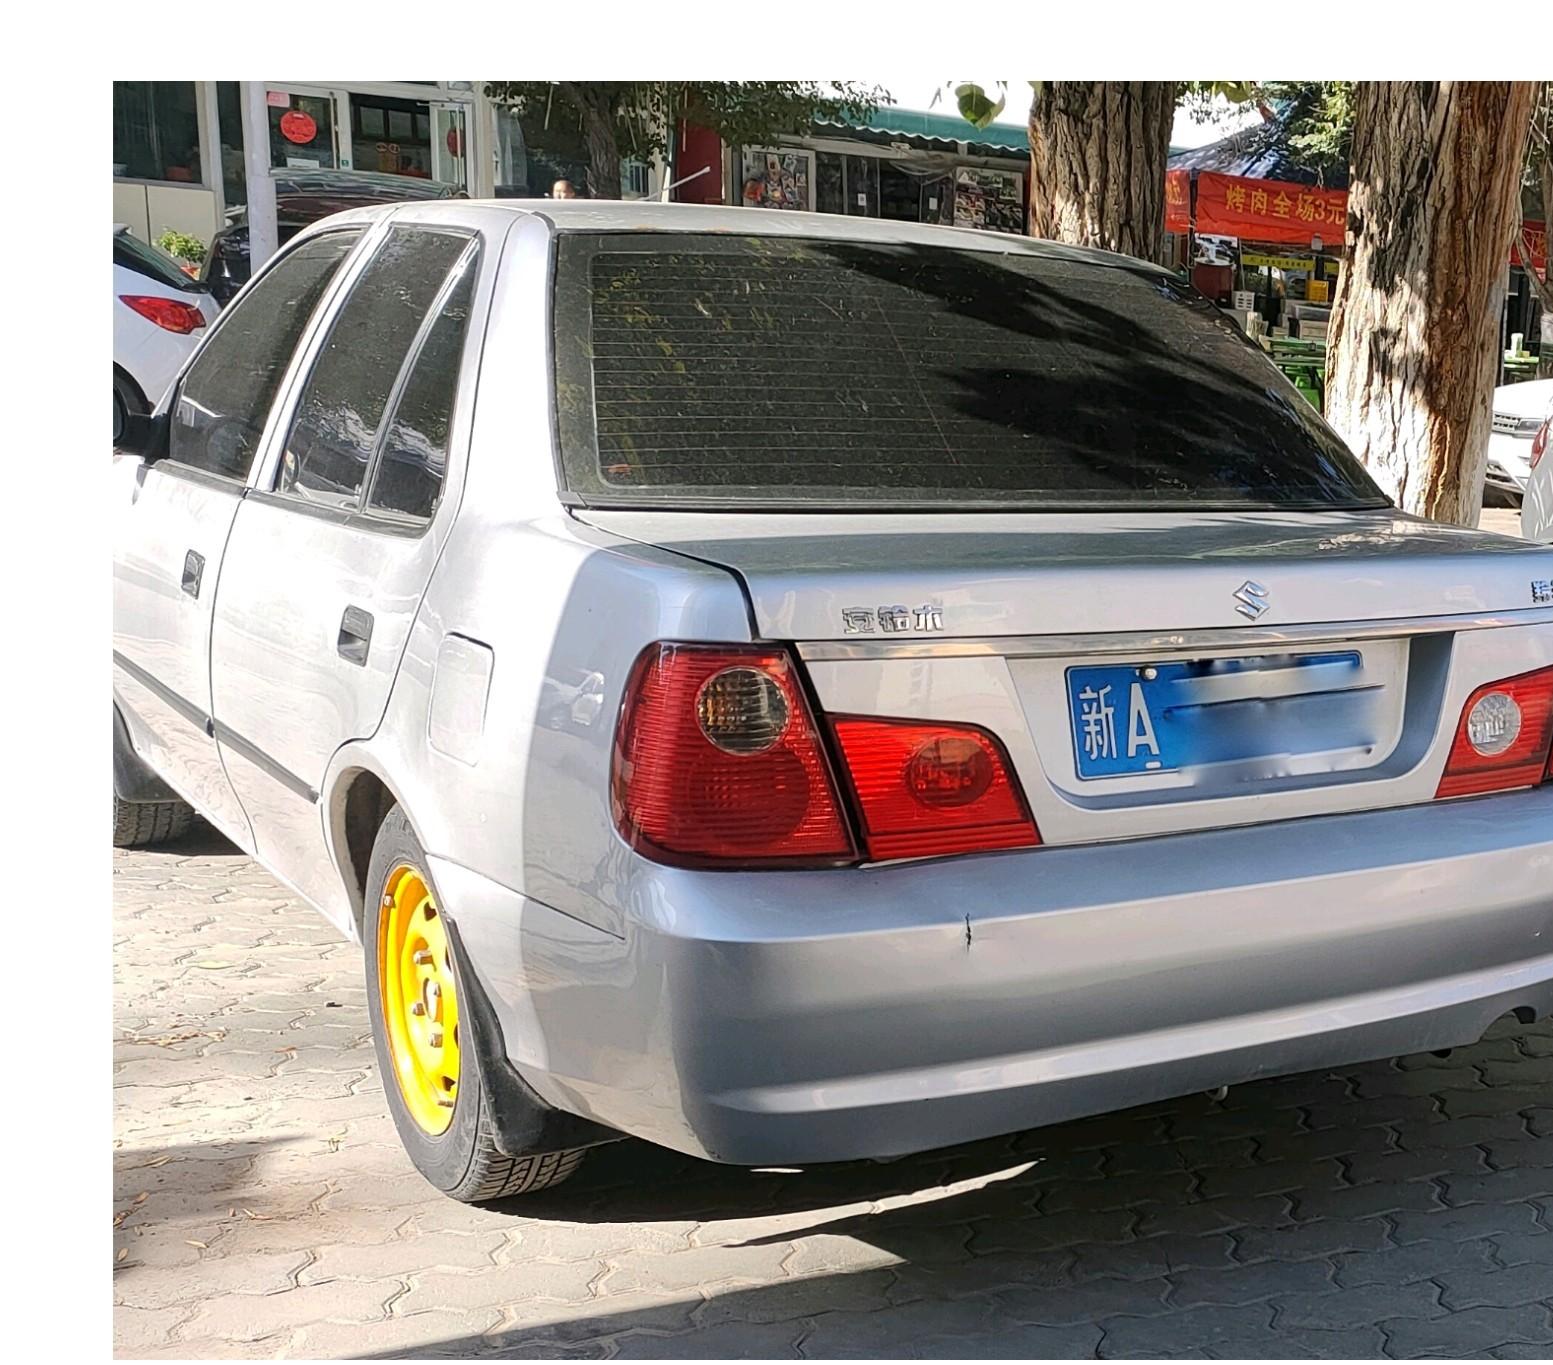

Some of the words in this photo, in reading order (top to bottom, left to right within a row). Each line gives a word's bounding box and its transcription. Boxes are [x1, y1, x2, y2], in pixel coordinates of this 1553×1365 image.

[1226, 184, 1346, 225] 烤肉全场3元
[1080, 682, 1161, 760] 新A
